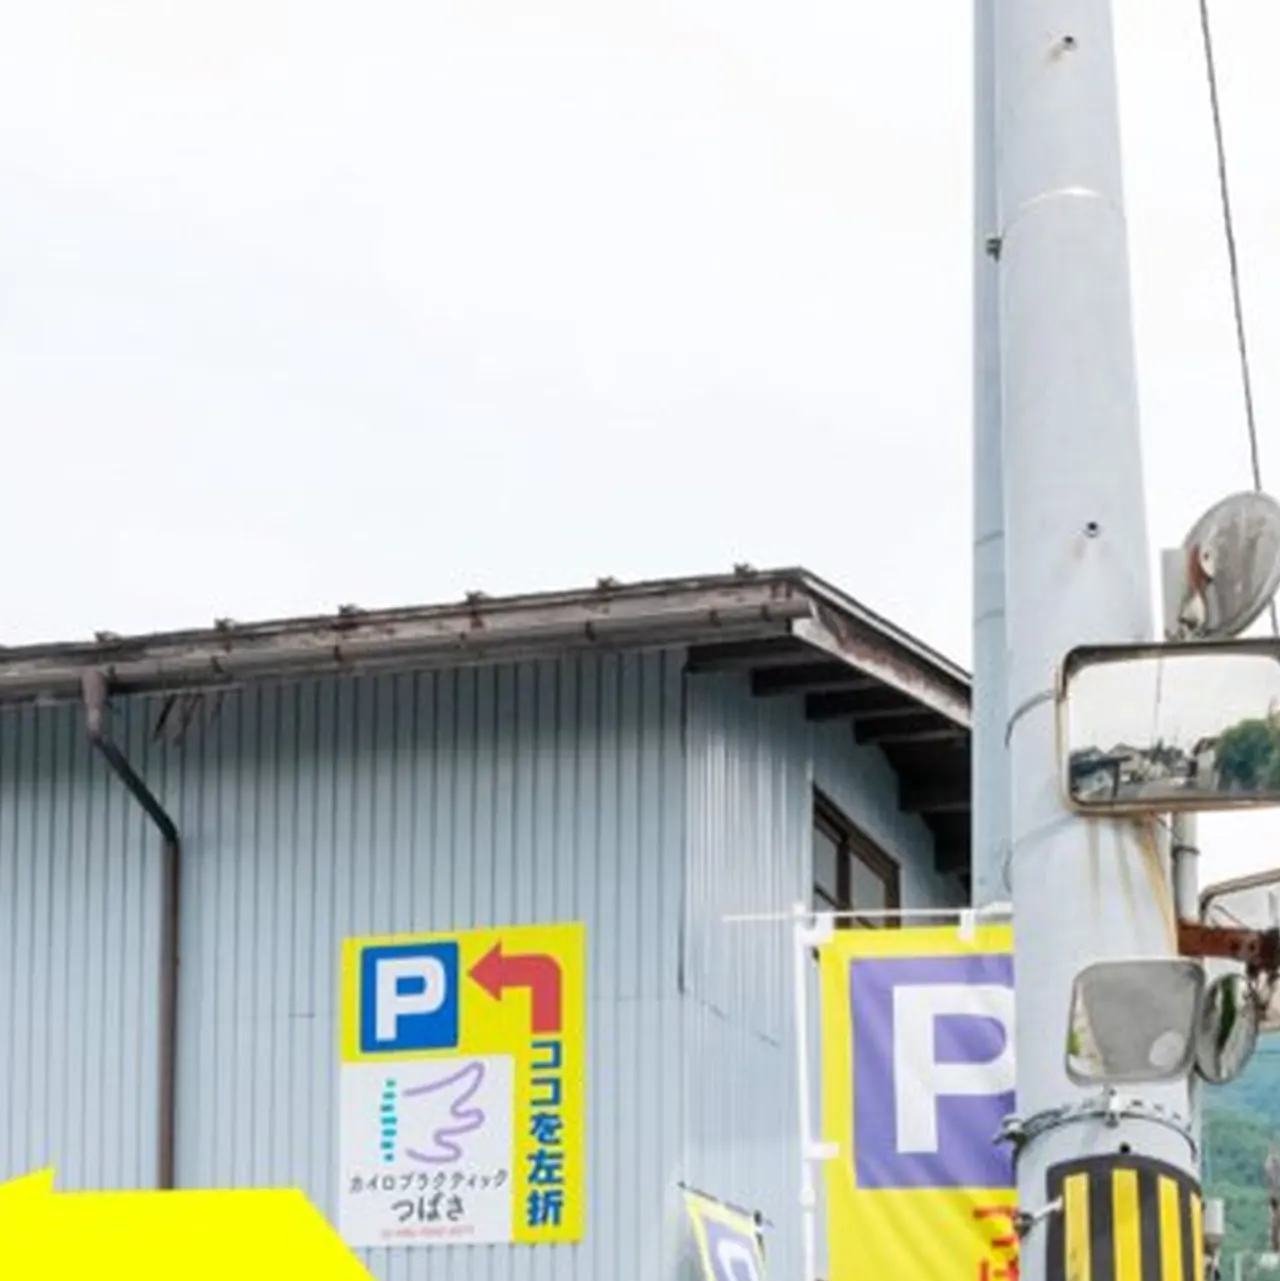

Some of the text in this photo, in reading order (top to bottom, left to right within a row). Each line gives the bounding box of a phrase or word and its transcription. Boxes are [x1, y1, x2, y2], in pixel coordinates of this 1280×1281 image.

[374, 955, 447, 1042] P
[892, 983, 1017, 1153] P
[526, 1040, 565, 1228] ココを左折
[390, 1191, 465, 1223] つばさ
